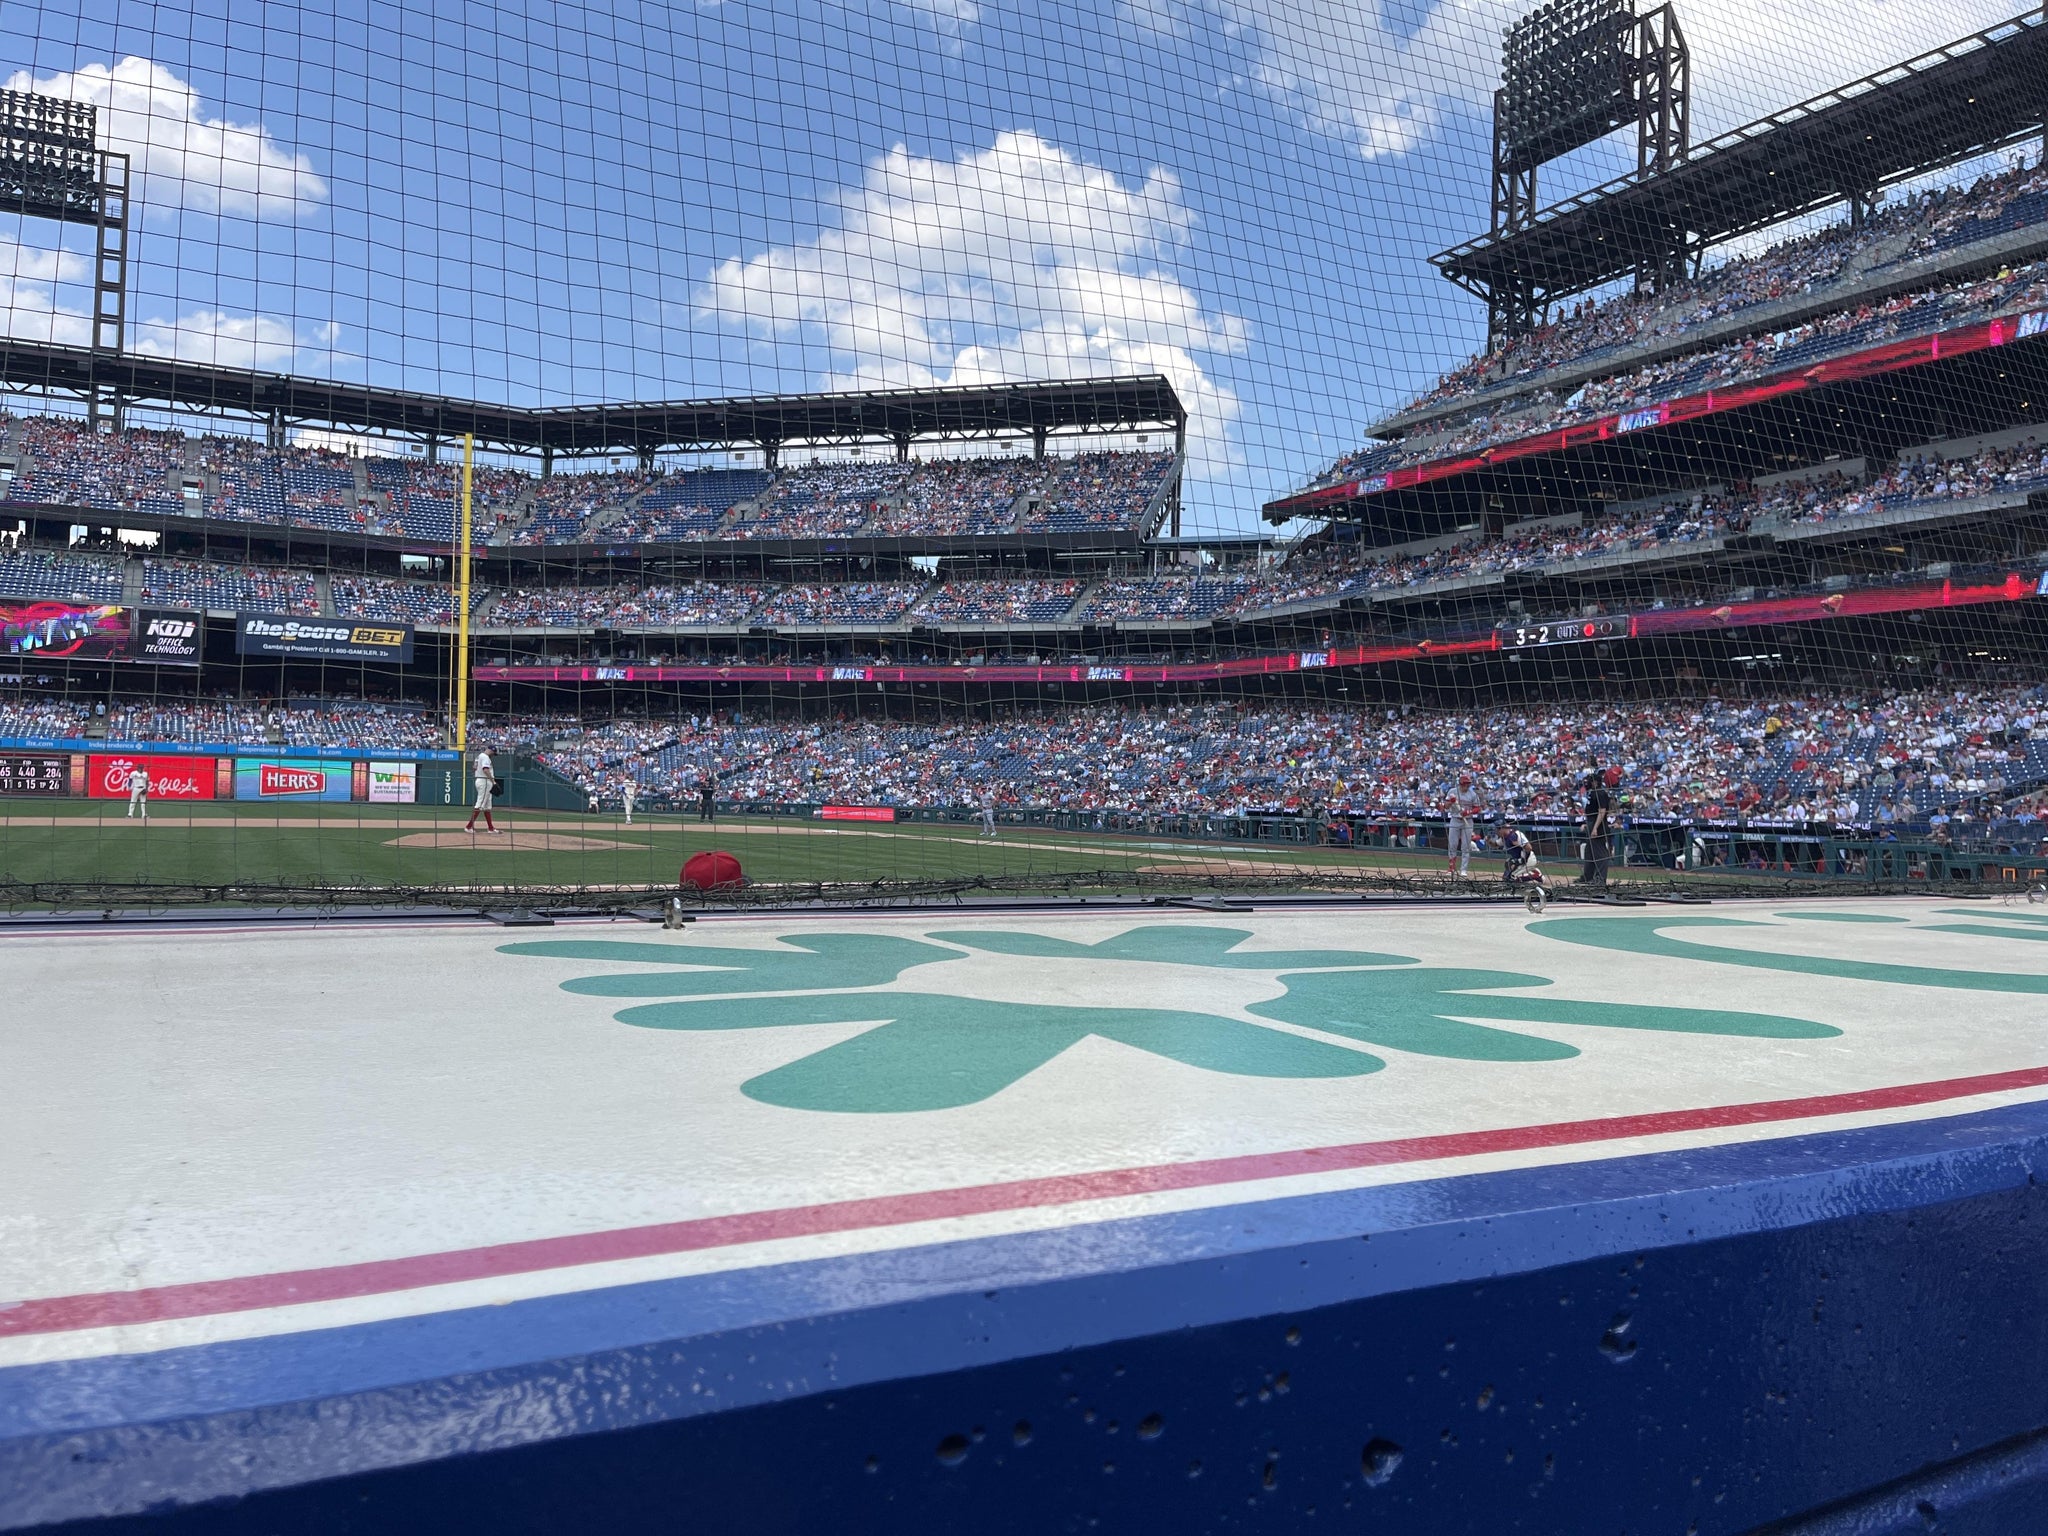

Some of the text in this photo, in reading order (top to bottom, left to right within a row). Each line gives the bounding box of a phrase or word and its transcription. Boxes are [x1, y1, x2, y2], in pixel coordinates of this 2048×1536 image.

[147, 619, 196, 638] KDI
[246, 620, 403, 643] theScore BET
[1556, 624, 1579, 639] OUTS
[157, 637, 184, 648] OFFICE
[144, 644, 196, 656] TECHNOLOGY
[595, 667, 626, 680] MAKE
[832, 667, 865, 680] MAKE
[237, 745, 279, 754] ndependence
[18, 767, 36, 777] 4.40
[26, 779, 36, 790] 15
[266, 772, 318, 790] HERR'S
